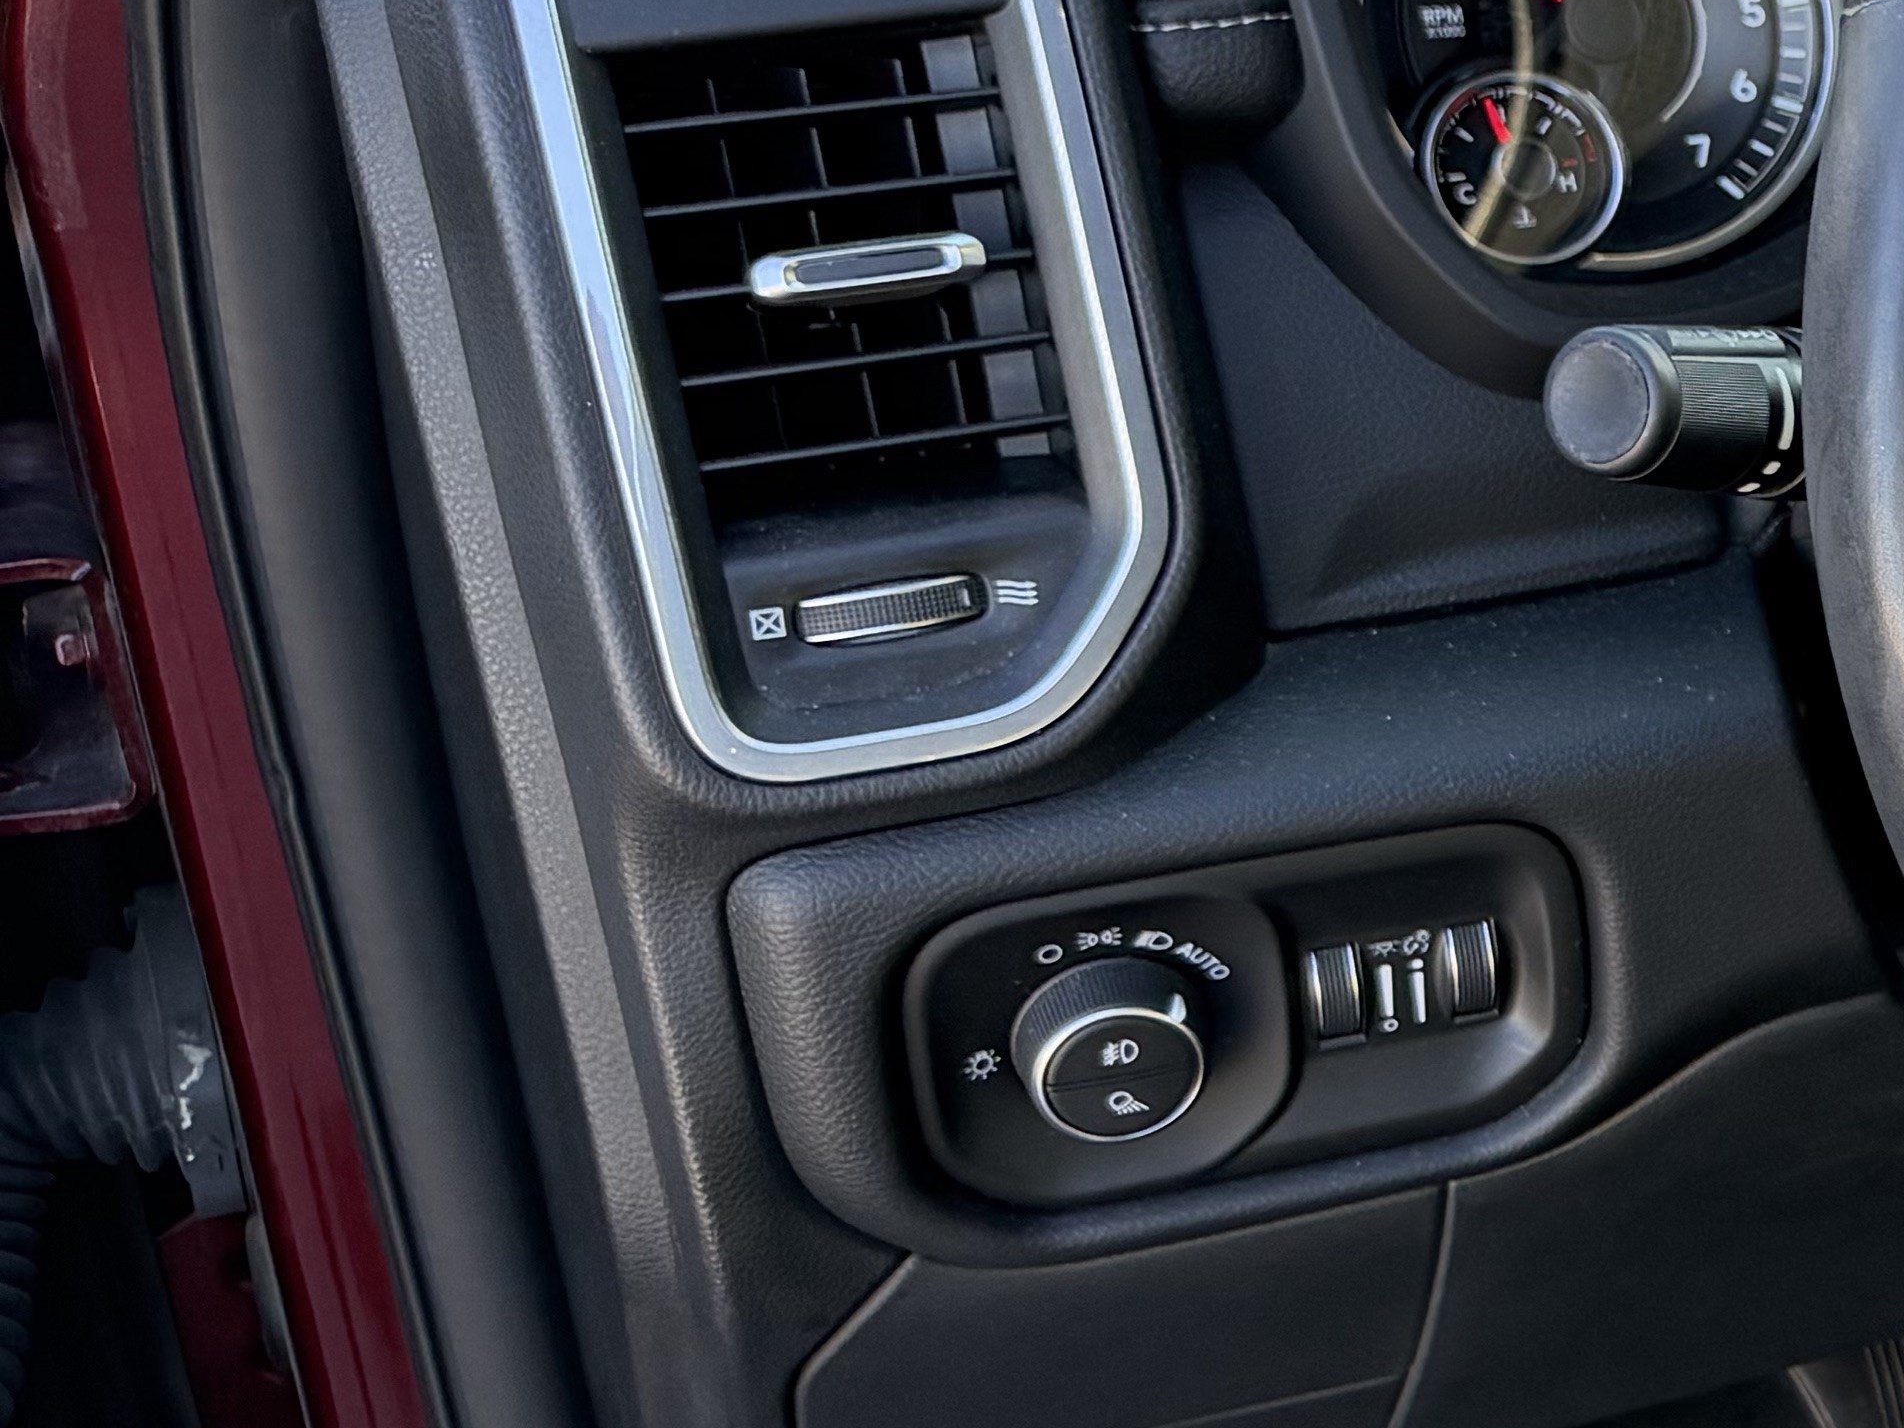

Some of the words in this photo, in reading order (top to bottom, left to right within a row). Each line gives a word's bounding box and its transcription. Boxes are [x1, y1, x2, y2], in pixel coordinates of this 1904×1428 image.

[1417, 3, 1466, 28] RPM
[1729, 68, 1758, 103] 6
[1684, 132, 1711, 169] 7
[1174, 940, 1231, 982] AUTO
